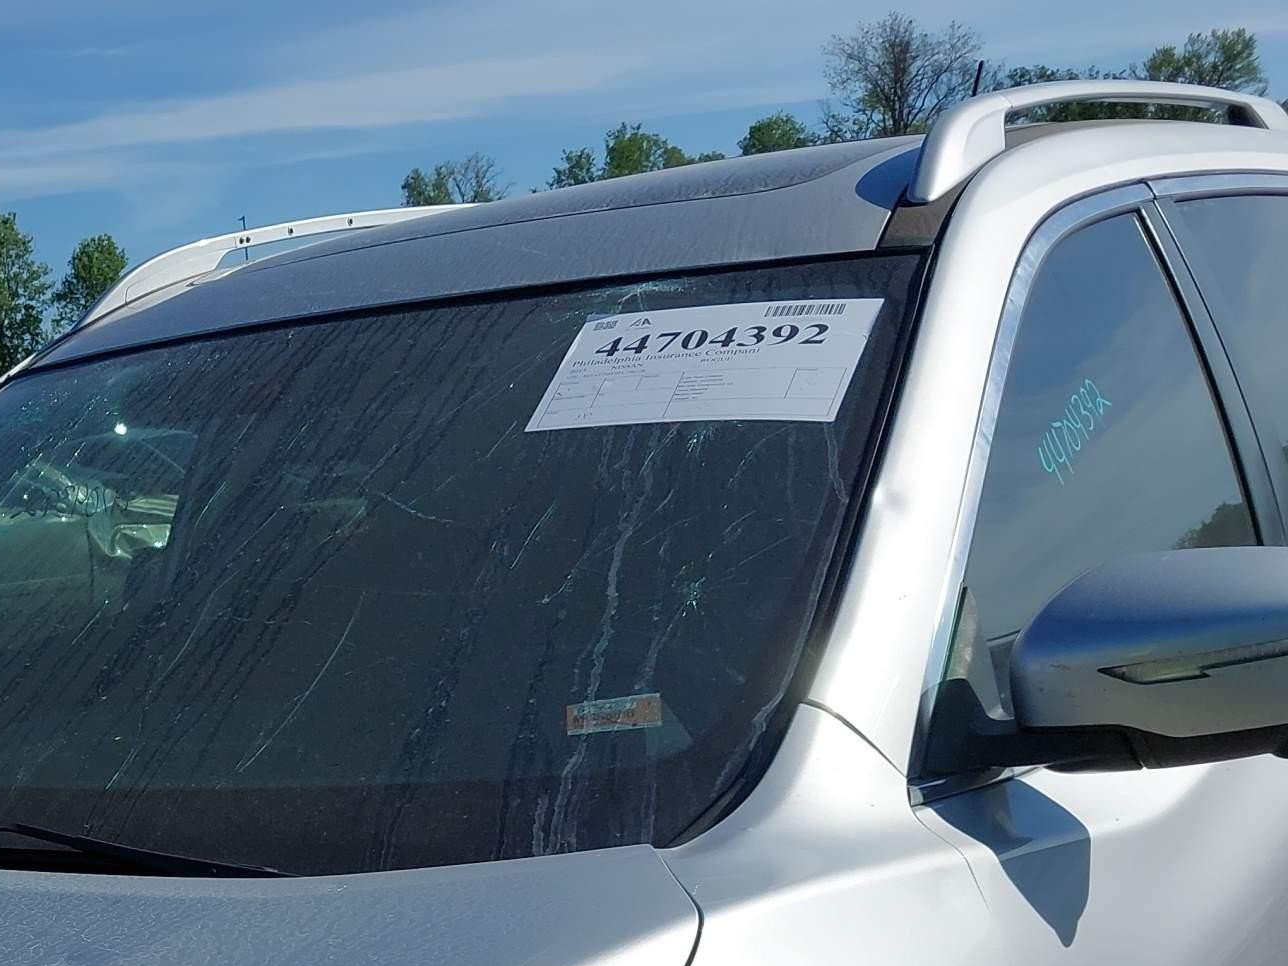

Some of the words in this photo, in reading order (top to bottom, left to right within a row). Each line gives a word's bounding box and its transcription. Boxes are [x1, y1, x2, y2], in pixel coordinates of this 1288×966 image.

[594, 323, 830, 358] 44704392
[571, 354, 643, 369] Philadelphia
[644, 349, 704, 362] Insurance
[1038, 379, 1112, 486] 44704392
